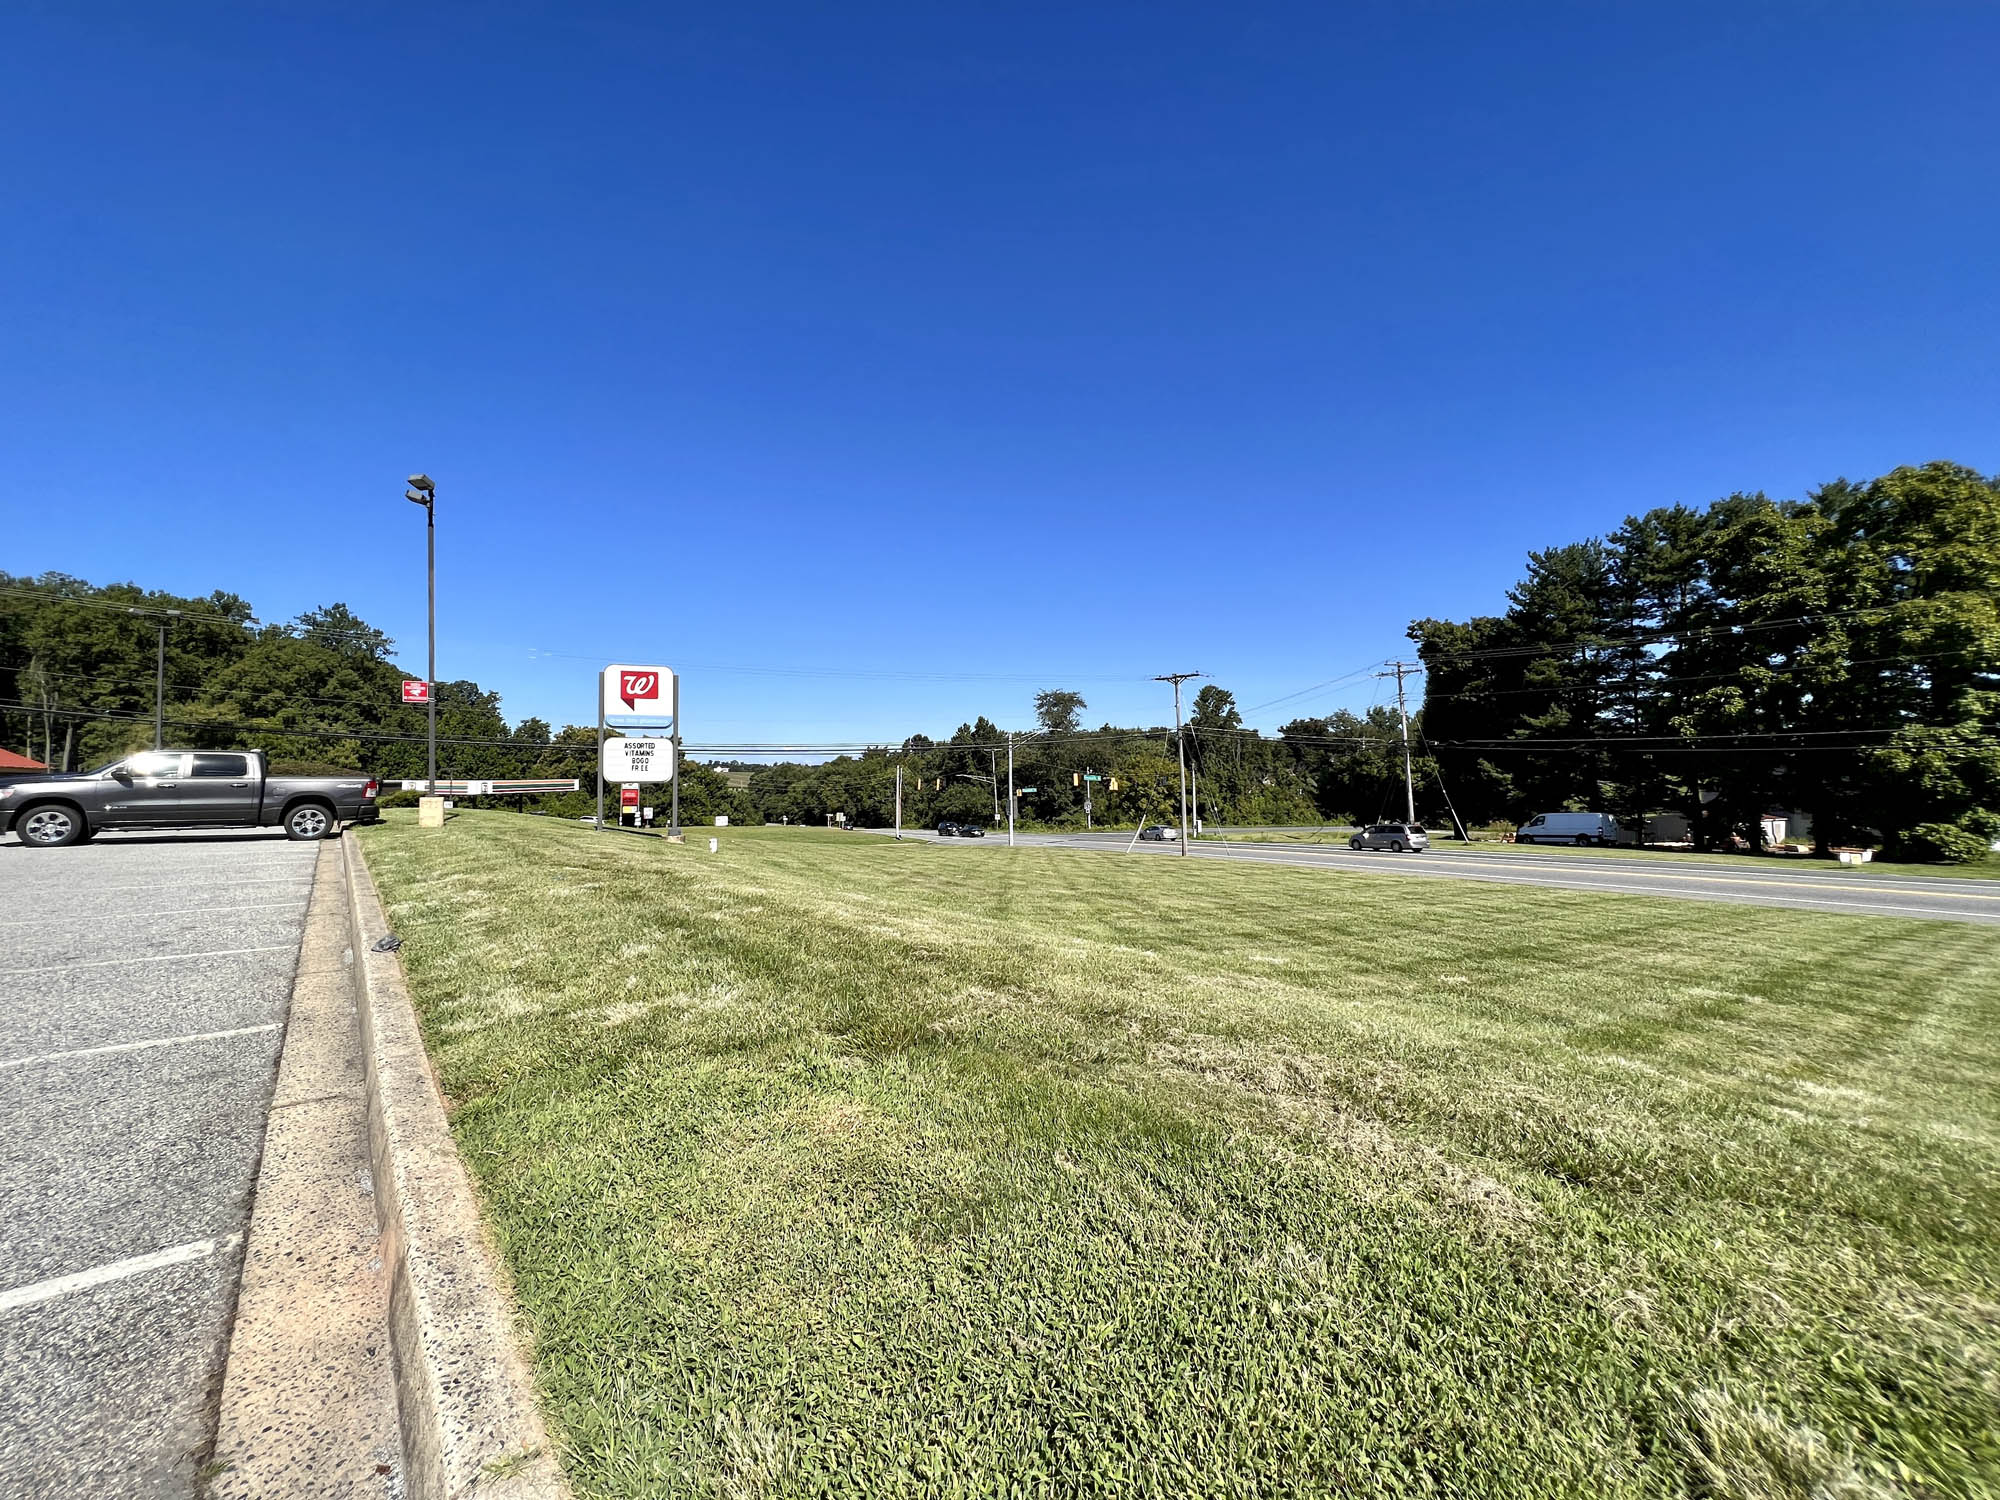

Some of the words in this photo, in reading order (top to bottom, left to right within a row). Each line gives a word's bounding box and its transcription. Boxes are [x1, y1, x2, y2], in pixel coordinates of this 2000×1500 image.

[624, 675, 655, 695] W
[624, 742, 656, 750] ASSORTED
[631, 764, 649, 772] FREE
